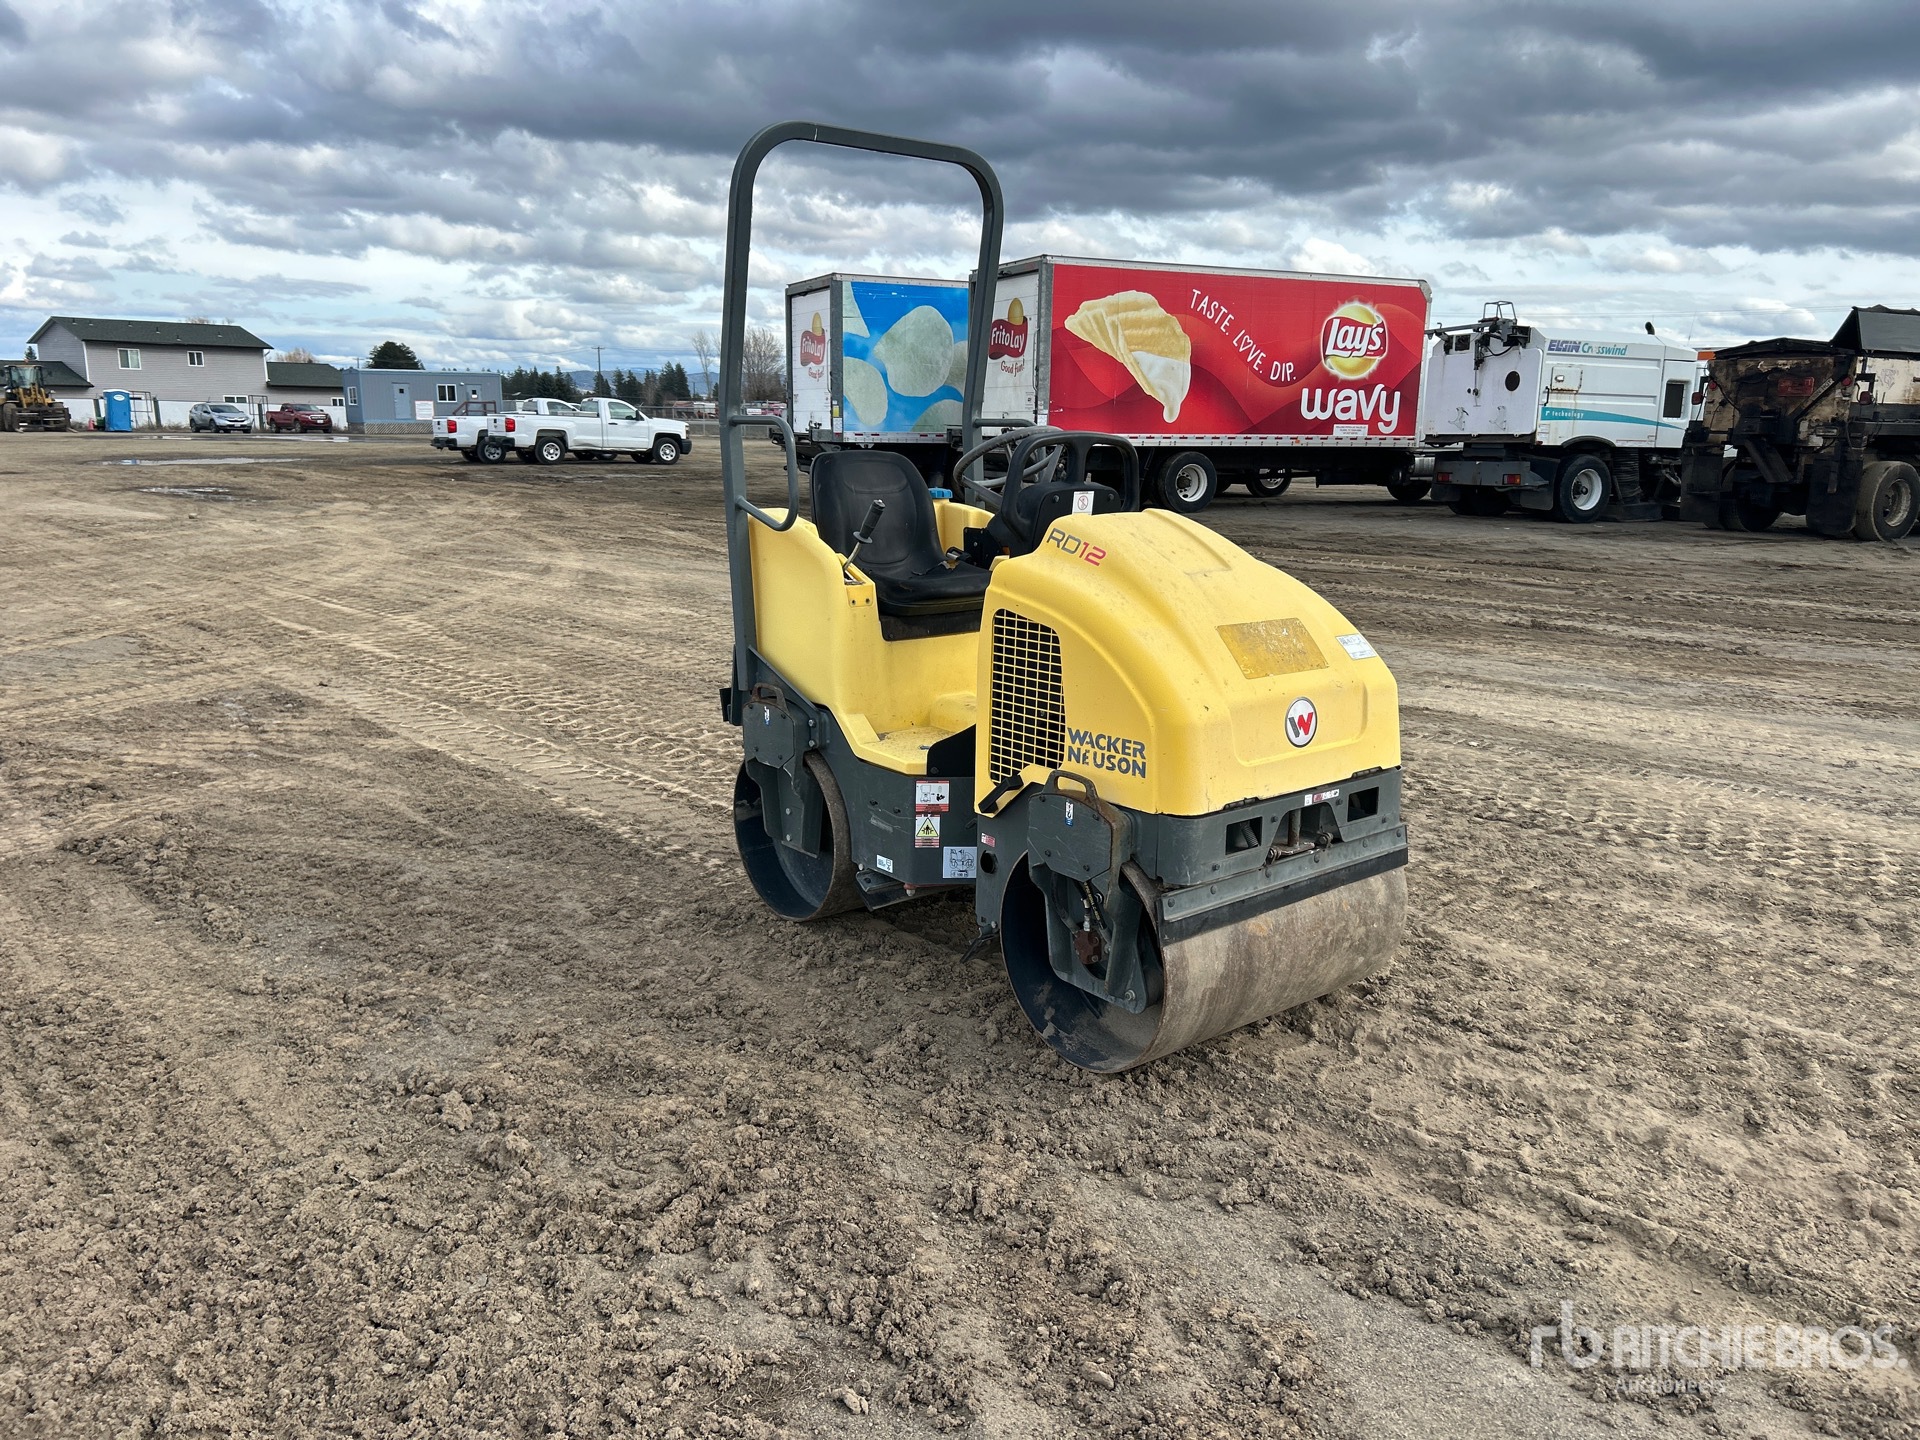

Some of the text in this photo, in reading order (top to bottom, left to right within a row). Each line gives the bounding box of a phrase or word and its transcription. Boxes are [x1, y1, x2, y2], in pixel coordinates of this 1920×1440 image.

[1190, 288, 1235, 336] TASTE.
[1270, 361, 1297, 382] DIP.
[1325, 318, 1384, 358] Lay's
[1547, 339, 1628, 356] ELGIN Crsswind
[1000, 360, 1013, 374] Good
[1300, 383, 1401, 434] wavy
[1551, 410, 1584, 419] technology
[1046, 527, 1107, 567] RD12
[1067, 727, 1146, 760] WACKER
